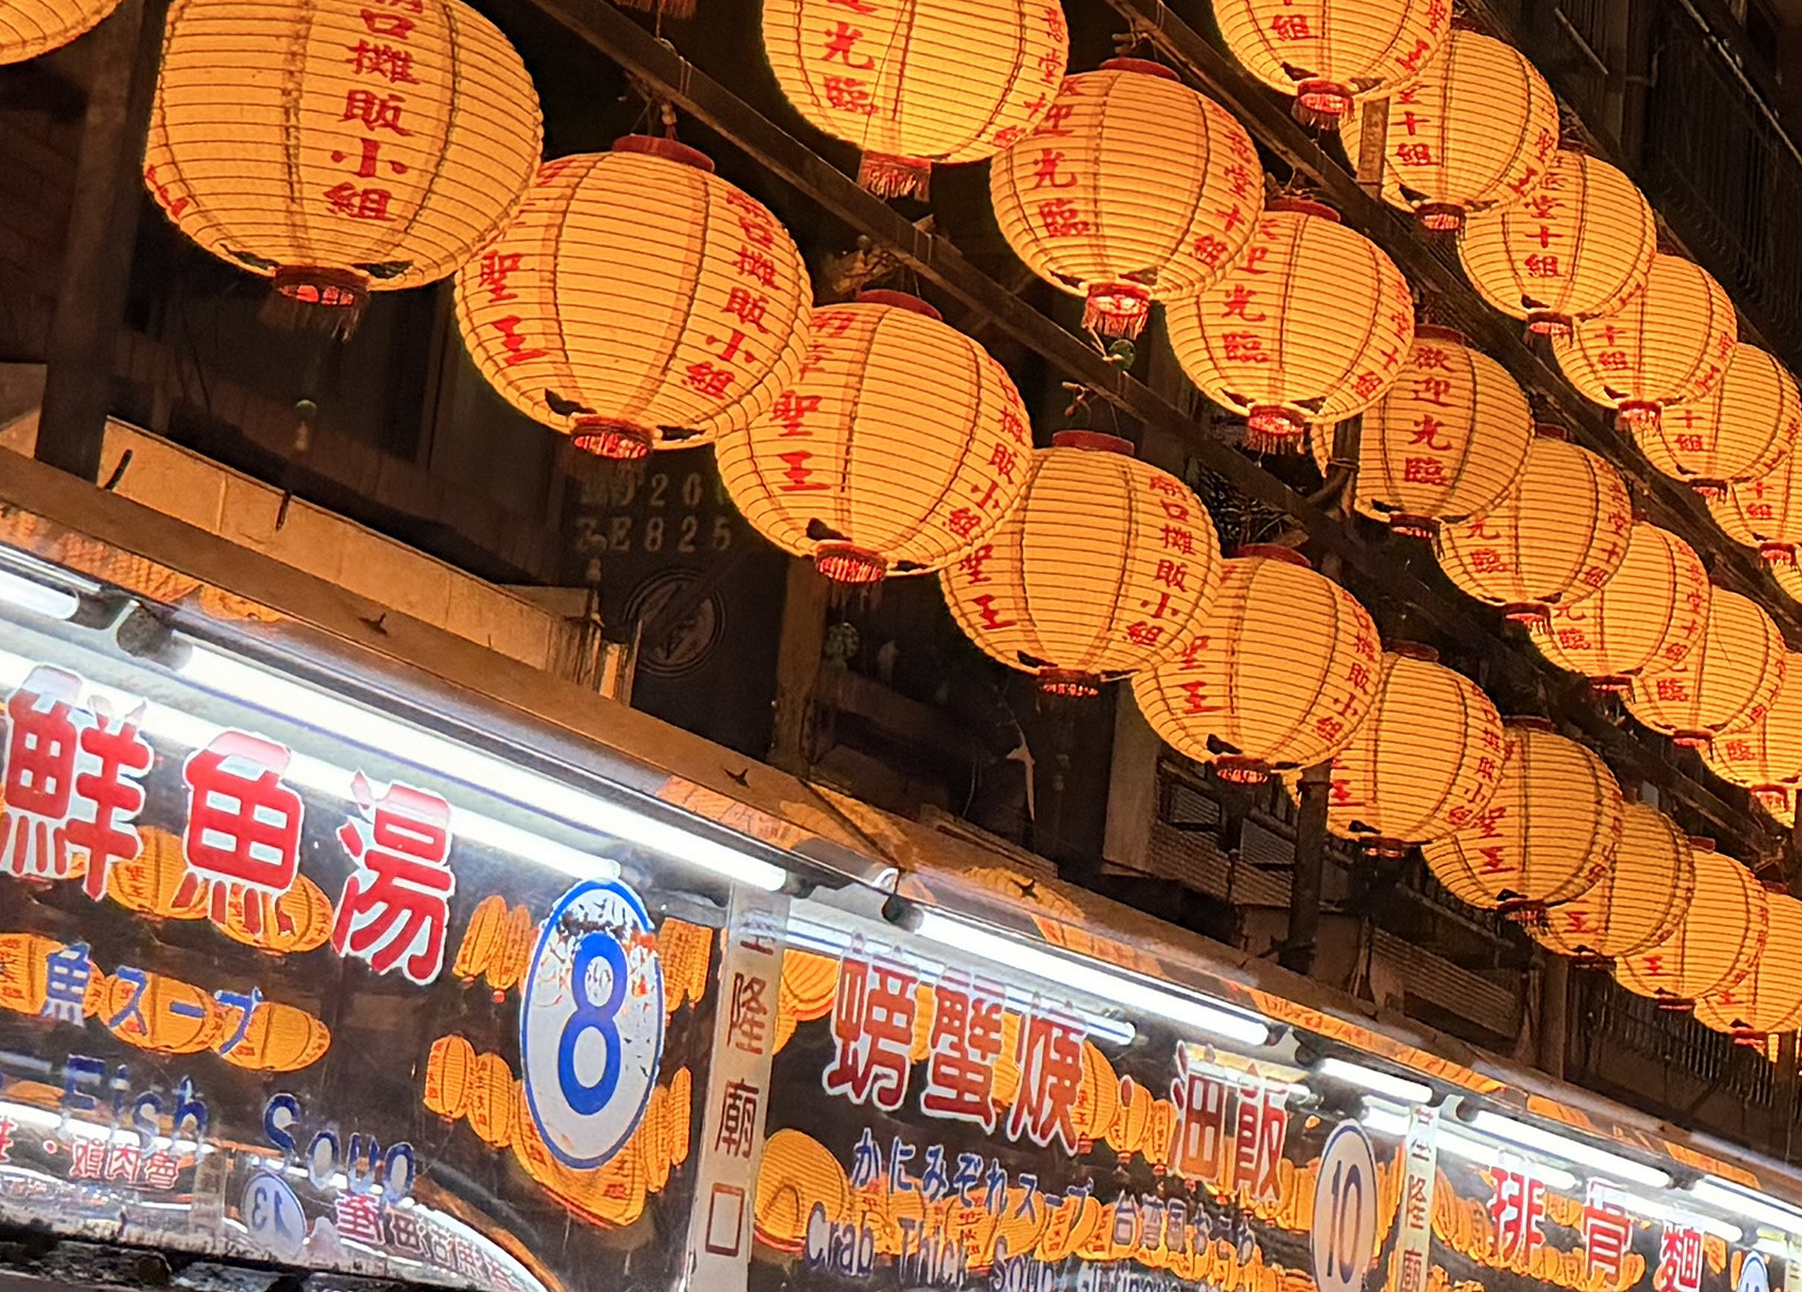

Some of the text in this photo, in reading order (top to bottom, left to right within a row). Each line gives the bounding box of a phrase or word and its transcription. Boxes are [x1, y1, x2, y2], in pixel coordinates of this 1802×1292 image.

[1404, 345, 1453, 487] 歡迎光臨
[0, 667, 458, 985] 鮮魚湯
[40, 941, 264, 1055] 魚スープ
[557, 931, 629, 1116] 8
[1174, 1041, 1289, 1205] 油飯
[806, 1200, 875, 1277] Crab
[1330, 1159, 1361, 1284] 10
